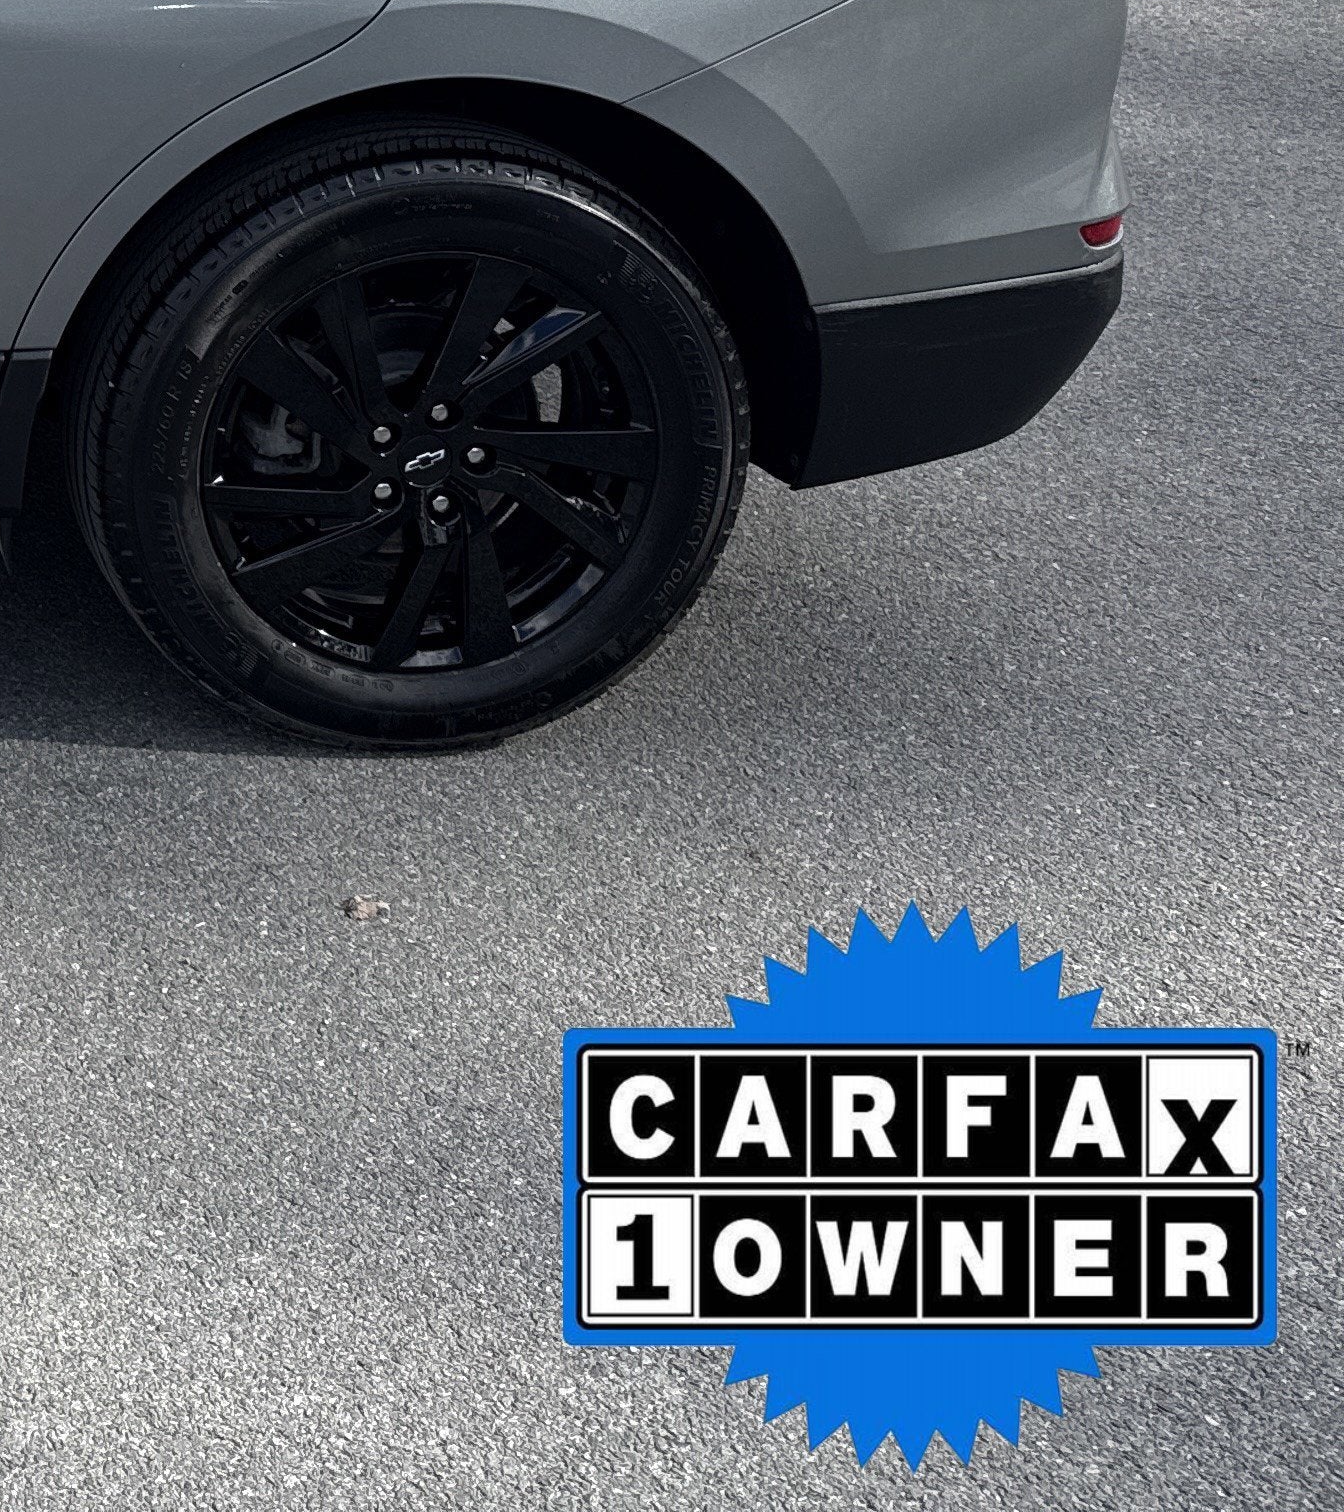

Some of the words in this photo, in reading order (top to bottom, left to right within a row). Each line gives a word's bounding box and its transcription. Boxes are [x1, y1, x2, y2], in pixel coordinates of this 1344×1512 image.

[651, 298, 720, 442] MICHELIN
[682, 464, 717, 553] PRIMACY
[652, 556, 692, 608] TOUR
